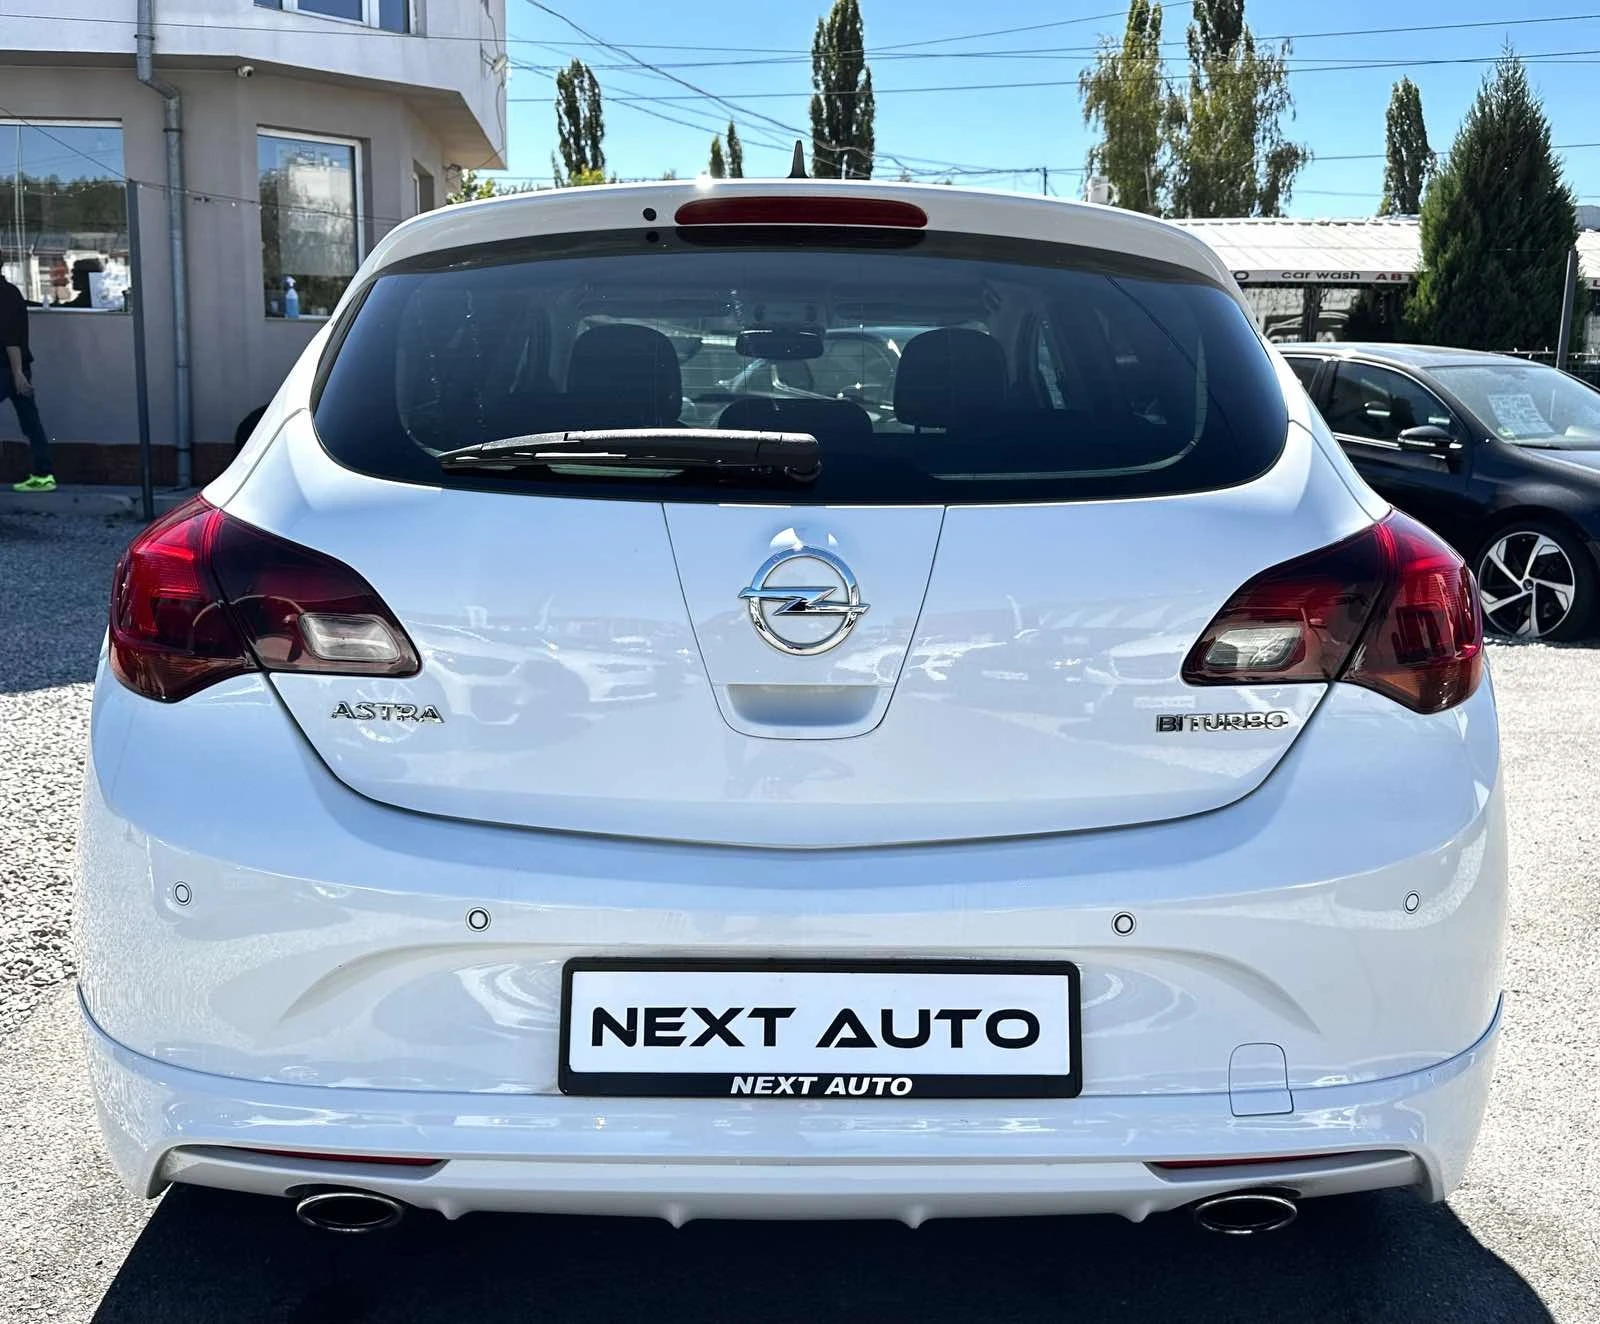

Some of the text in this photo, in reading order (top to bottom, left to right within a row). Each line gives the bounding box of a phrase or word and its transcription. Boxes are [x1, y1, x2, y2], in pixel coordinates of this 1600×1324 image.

[1281, 271, 1310, 279] car
[1316, 271, 1360, 280] wash
[330, 701, 444, 723] ASTRA
[591, 1007, 1040, 1049] NEXT AUTO
[730, 1076, 913, 1096] NEXT AUTO
